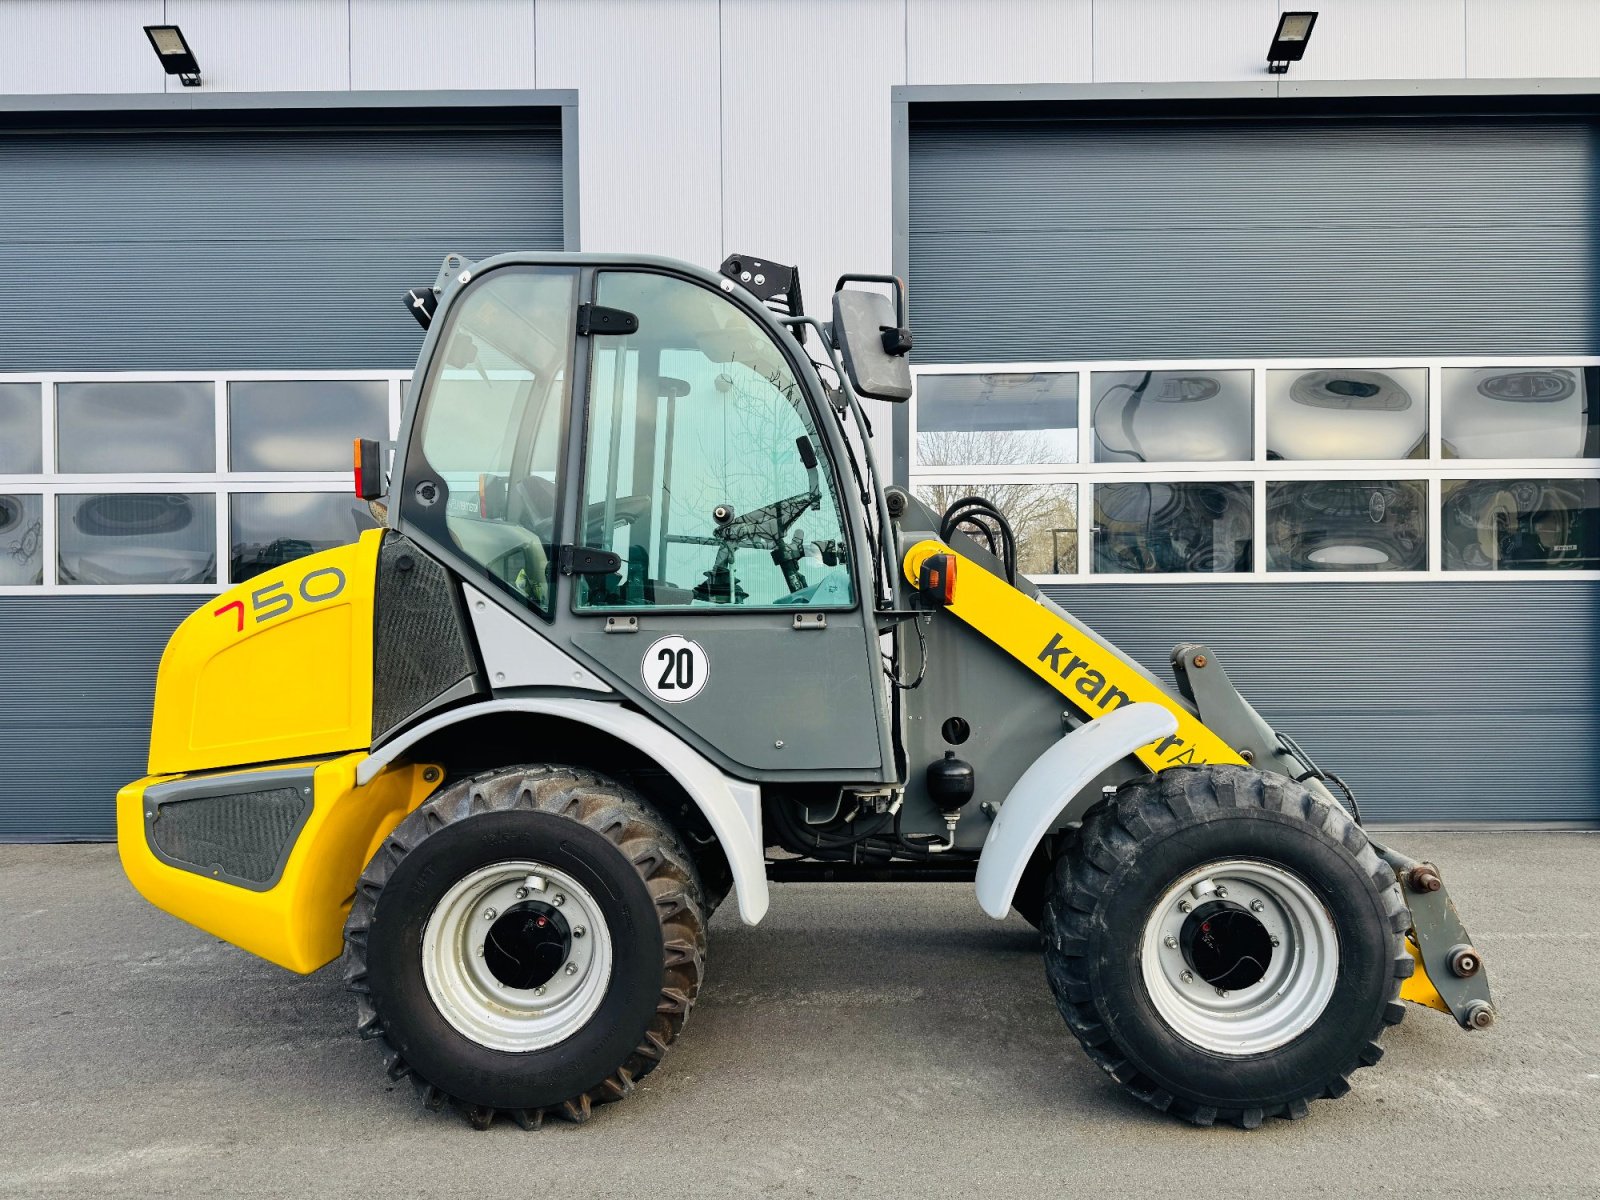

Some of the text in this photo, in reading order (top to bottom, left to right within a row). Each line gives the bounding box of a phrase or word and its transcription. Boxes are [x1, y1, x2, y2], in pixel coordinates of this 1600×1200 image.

[213, 566, 346, 632] 750
[657, 647, 694, 690] 20
[1036, 632, 1185, 757] krar
